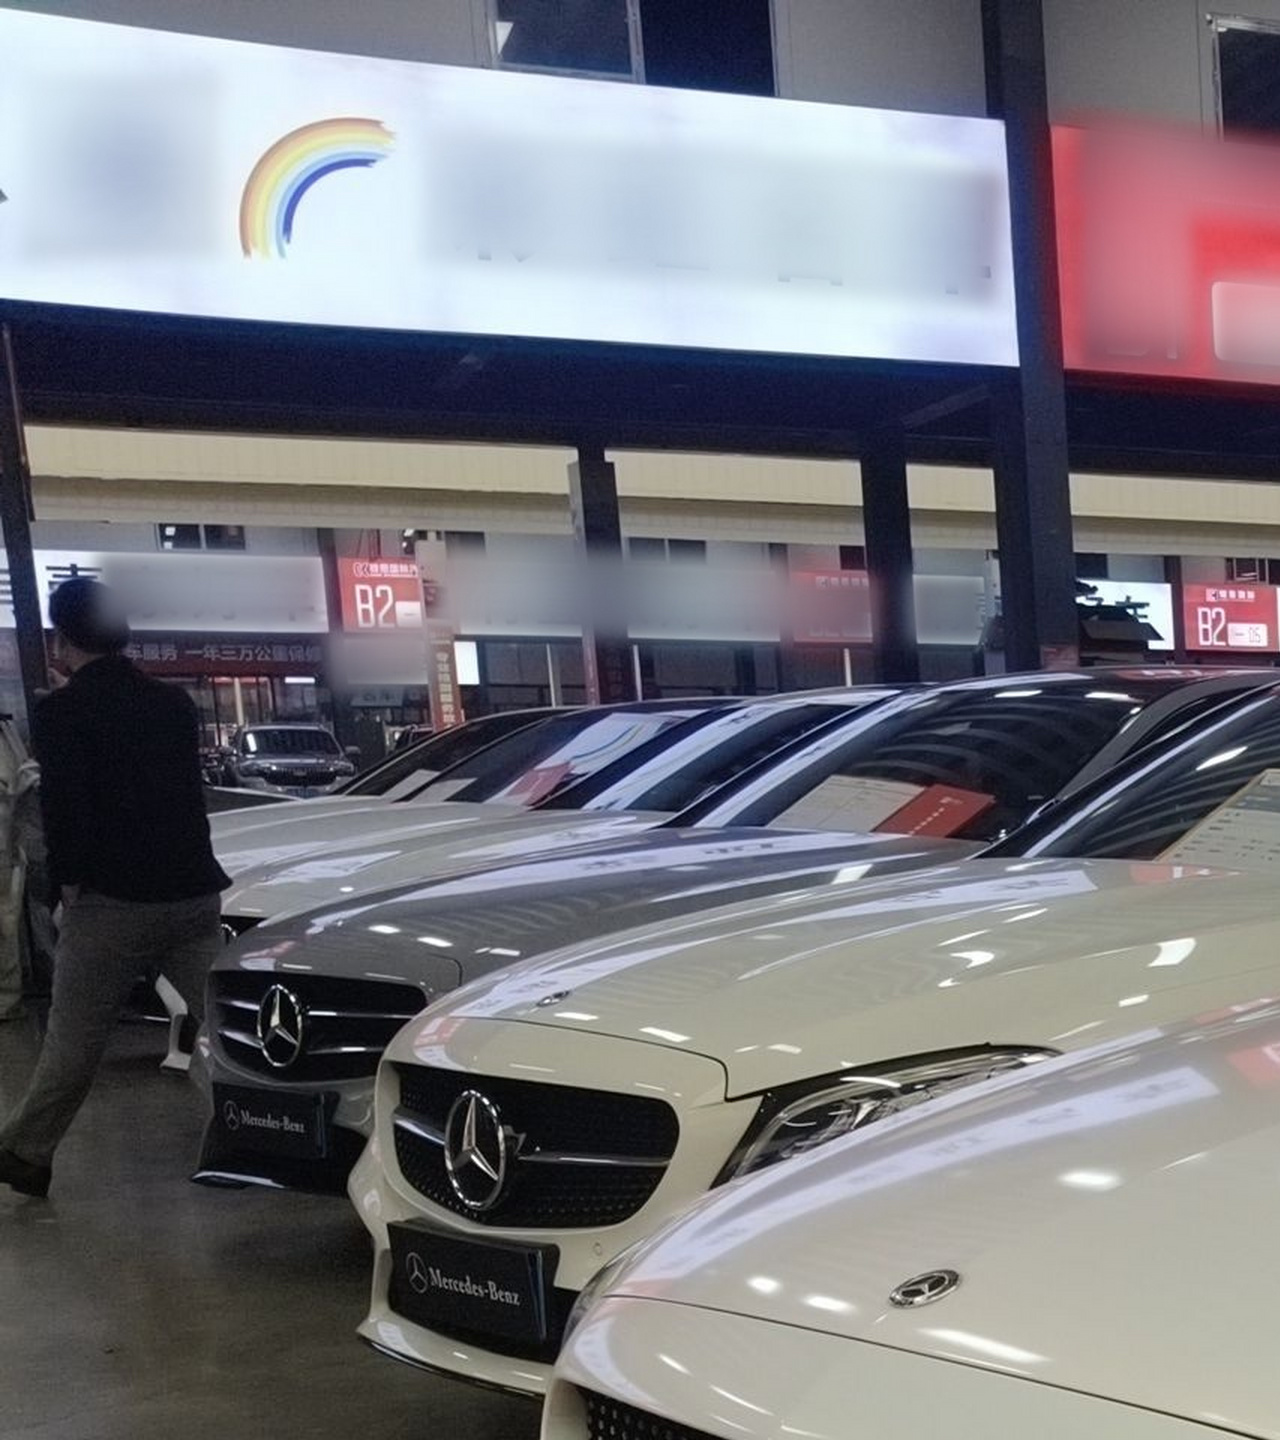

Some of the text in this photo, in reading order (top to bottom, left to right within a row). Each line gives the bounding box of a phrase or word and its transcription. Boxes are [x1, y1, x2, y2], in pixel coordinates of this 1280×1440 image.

[355, 584, 395, 628] B2
[1197, 607, 1227, 646] B2
[241, 1111, 306, 1134] Mercedes-Benz
[429, 1266, 521, 1308] Mercedes-Benz
